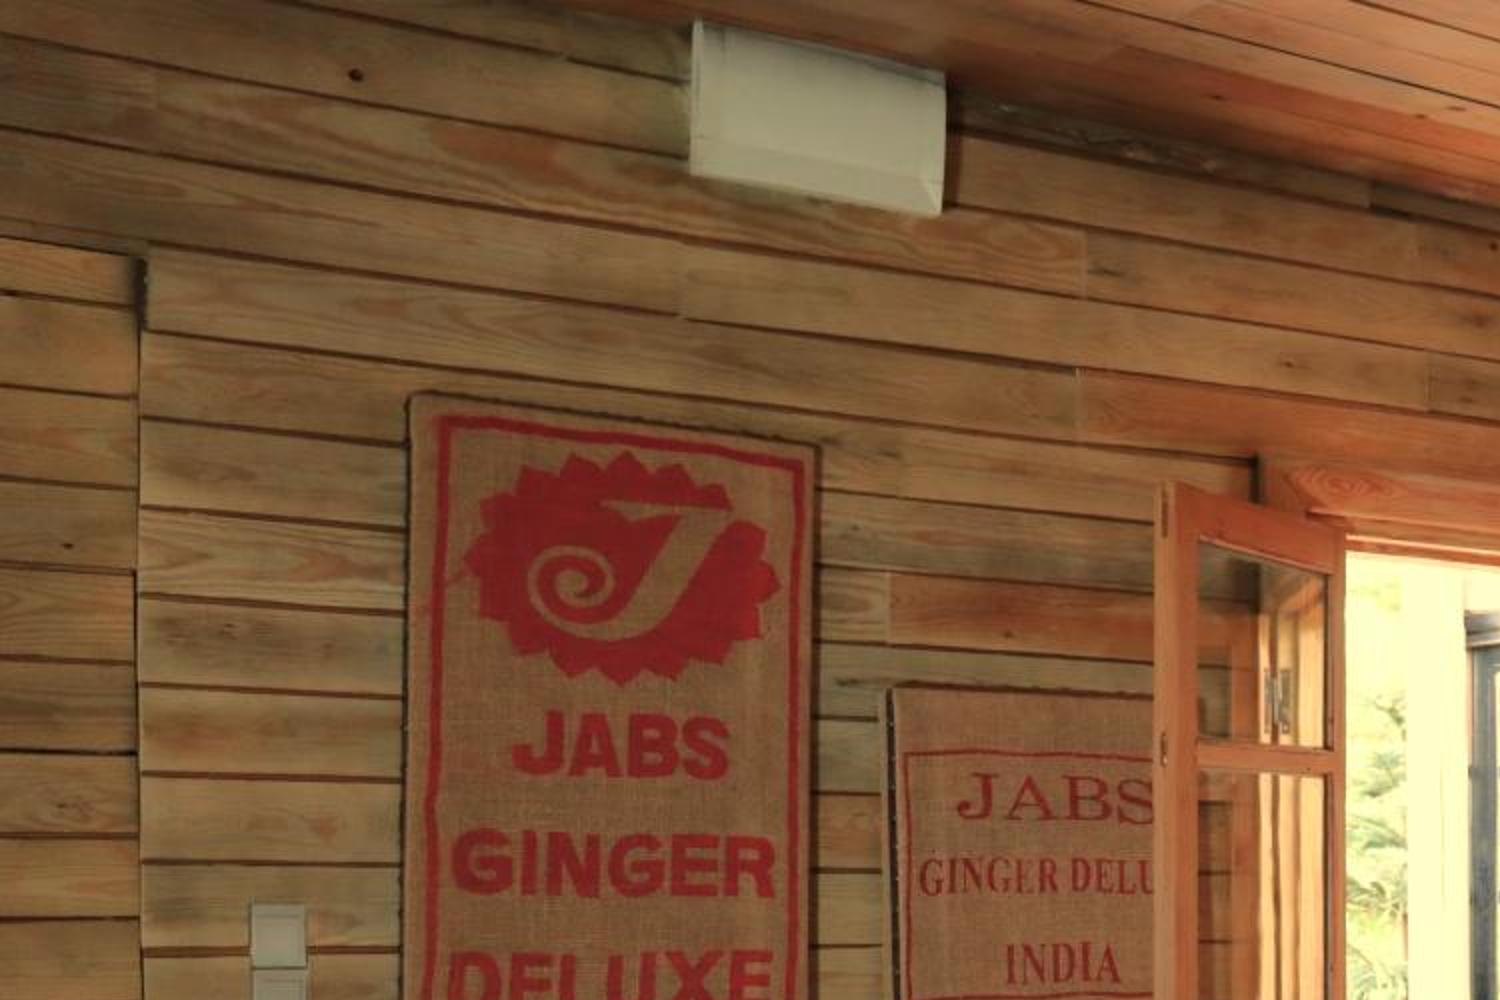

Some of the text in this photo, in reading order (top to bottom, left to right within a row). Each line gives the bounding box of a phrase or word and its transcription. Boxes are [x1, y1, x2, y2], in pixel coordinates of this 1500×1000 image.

[513, 711, 731, 779] JABS
[957, 772, 1154, 825] JABS
[450, 827, 776, 898] GINGER
[919, 856, 1154, 896] GINGER DELU
[1006, 942, 1122, 985] INDIA
